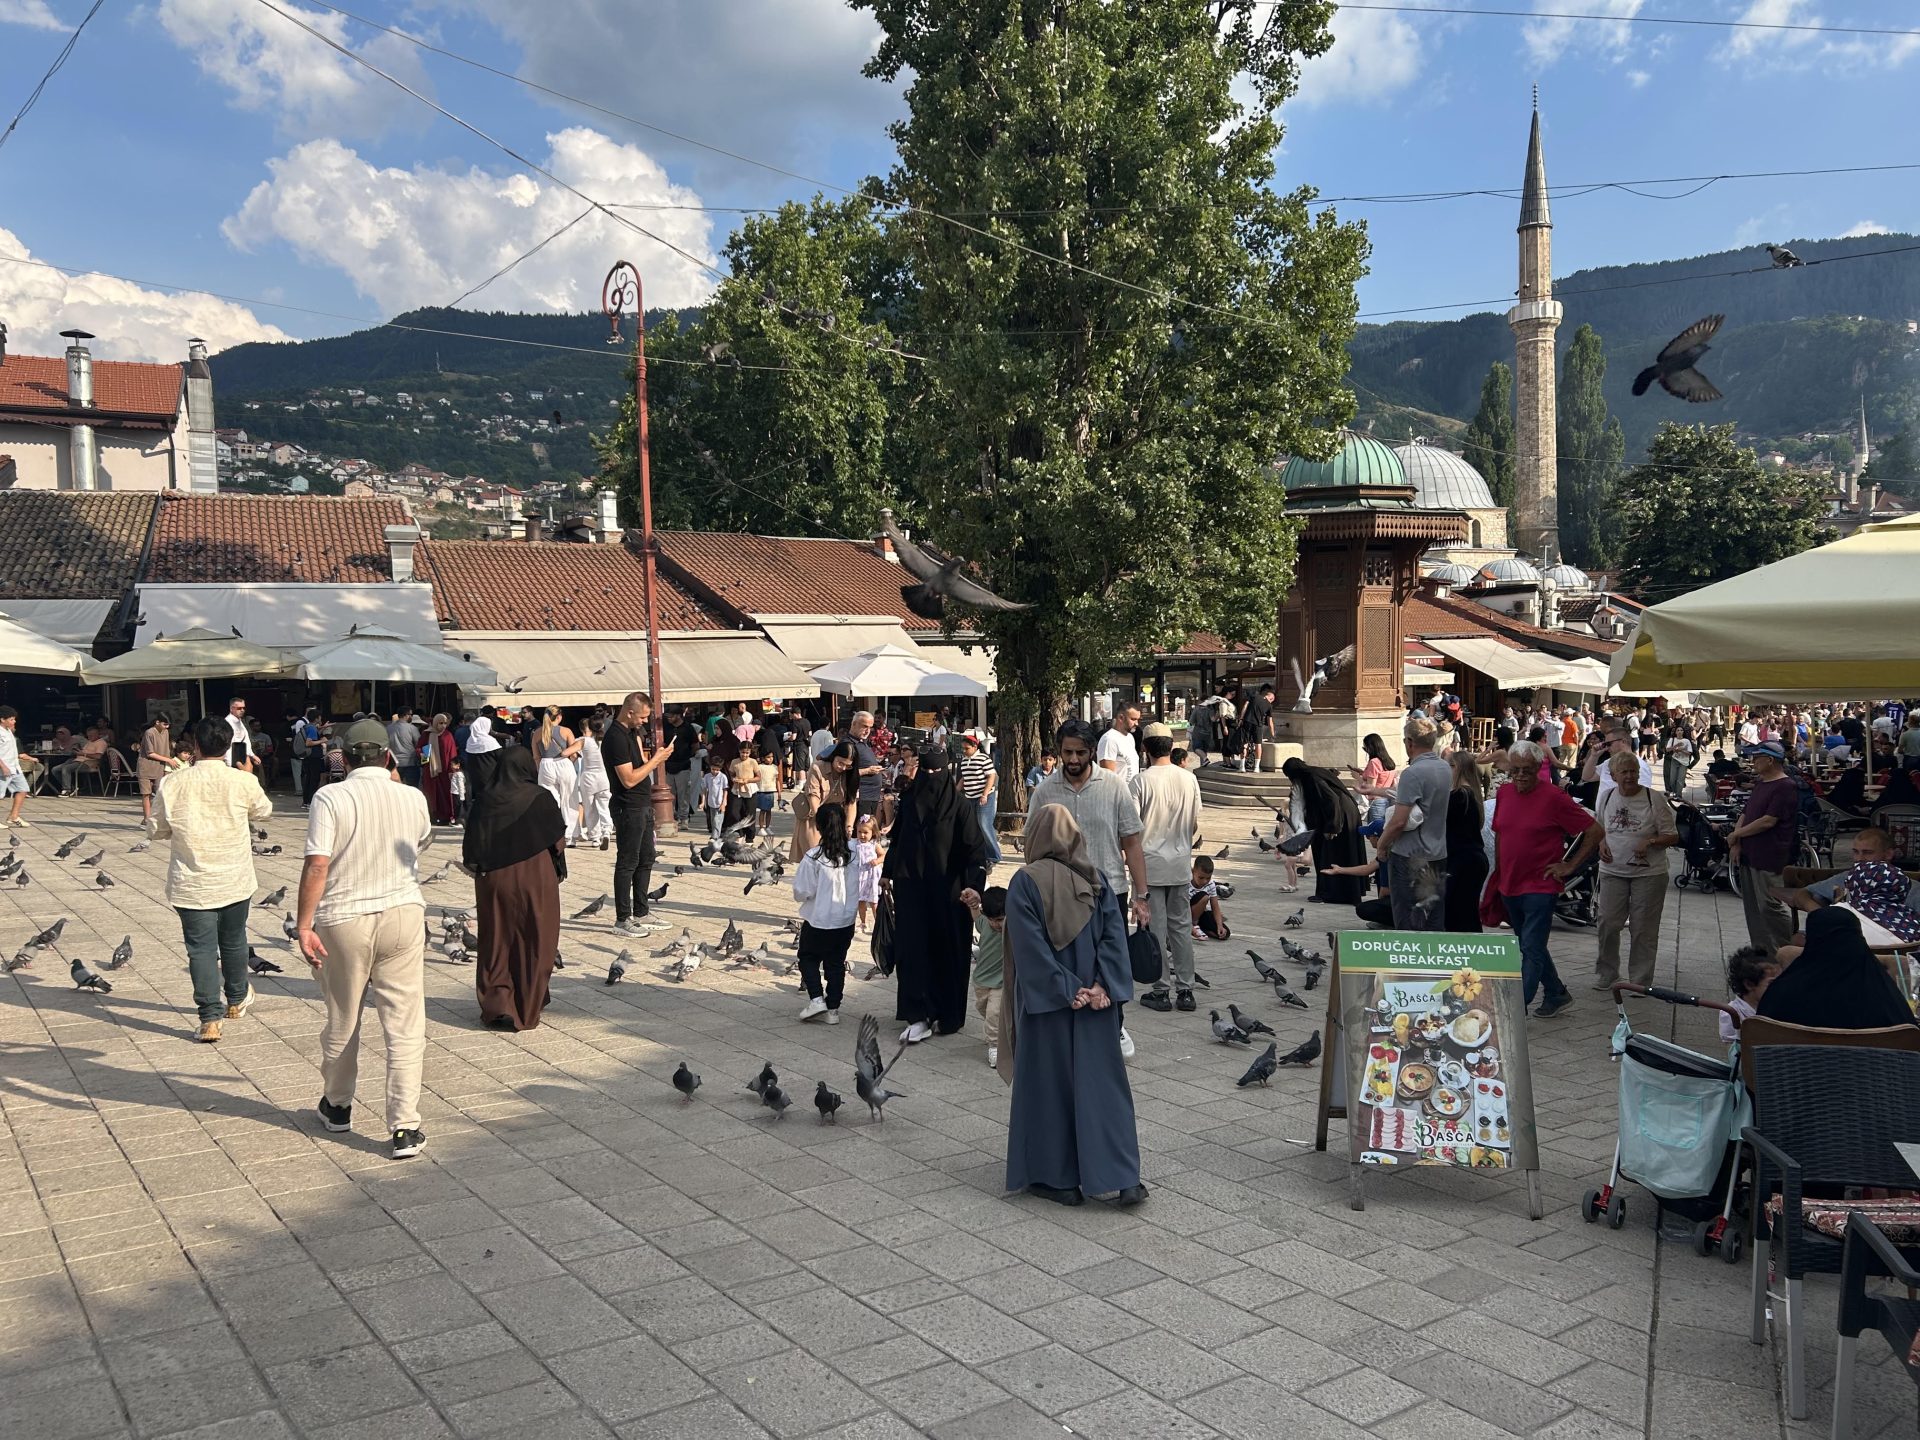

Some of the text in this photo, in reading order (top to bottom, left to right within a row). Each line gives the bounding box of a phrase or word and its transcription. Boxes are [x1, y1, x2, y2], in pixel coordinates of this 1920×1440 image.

[1888, 711, 1898, 719] 11
[1352, 940, 1505, 955] DORUČAK KAHVALTI
[1389, 954, 1470, 966] BREAKFAST
[1399, 990, 1436, 1008] BAŠČA
[1420, 1124, 1474, 1147] BAŠČA
